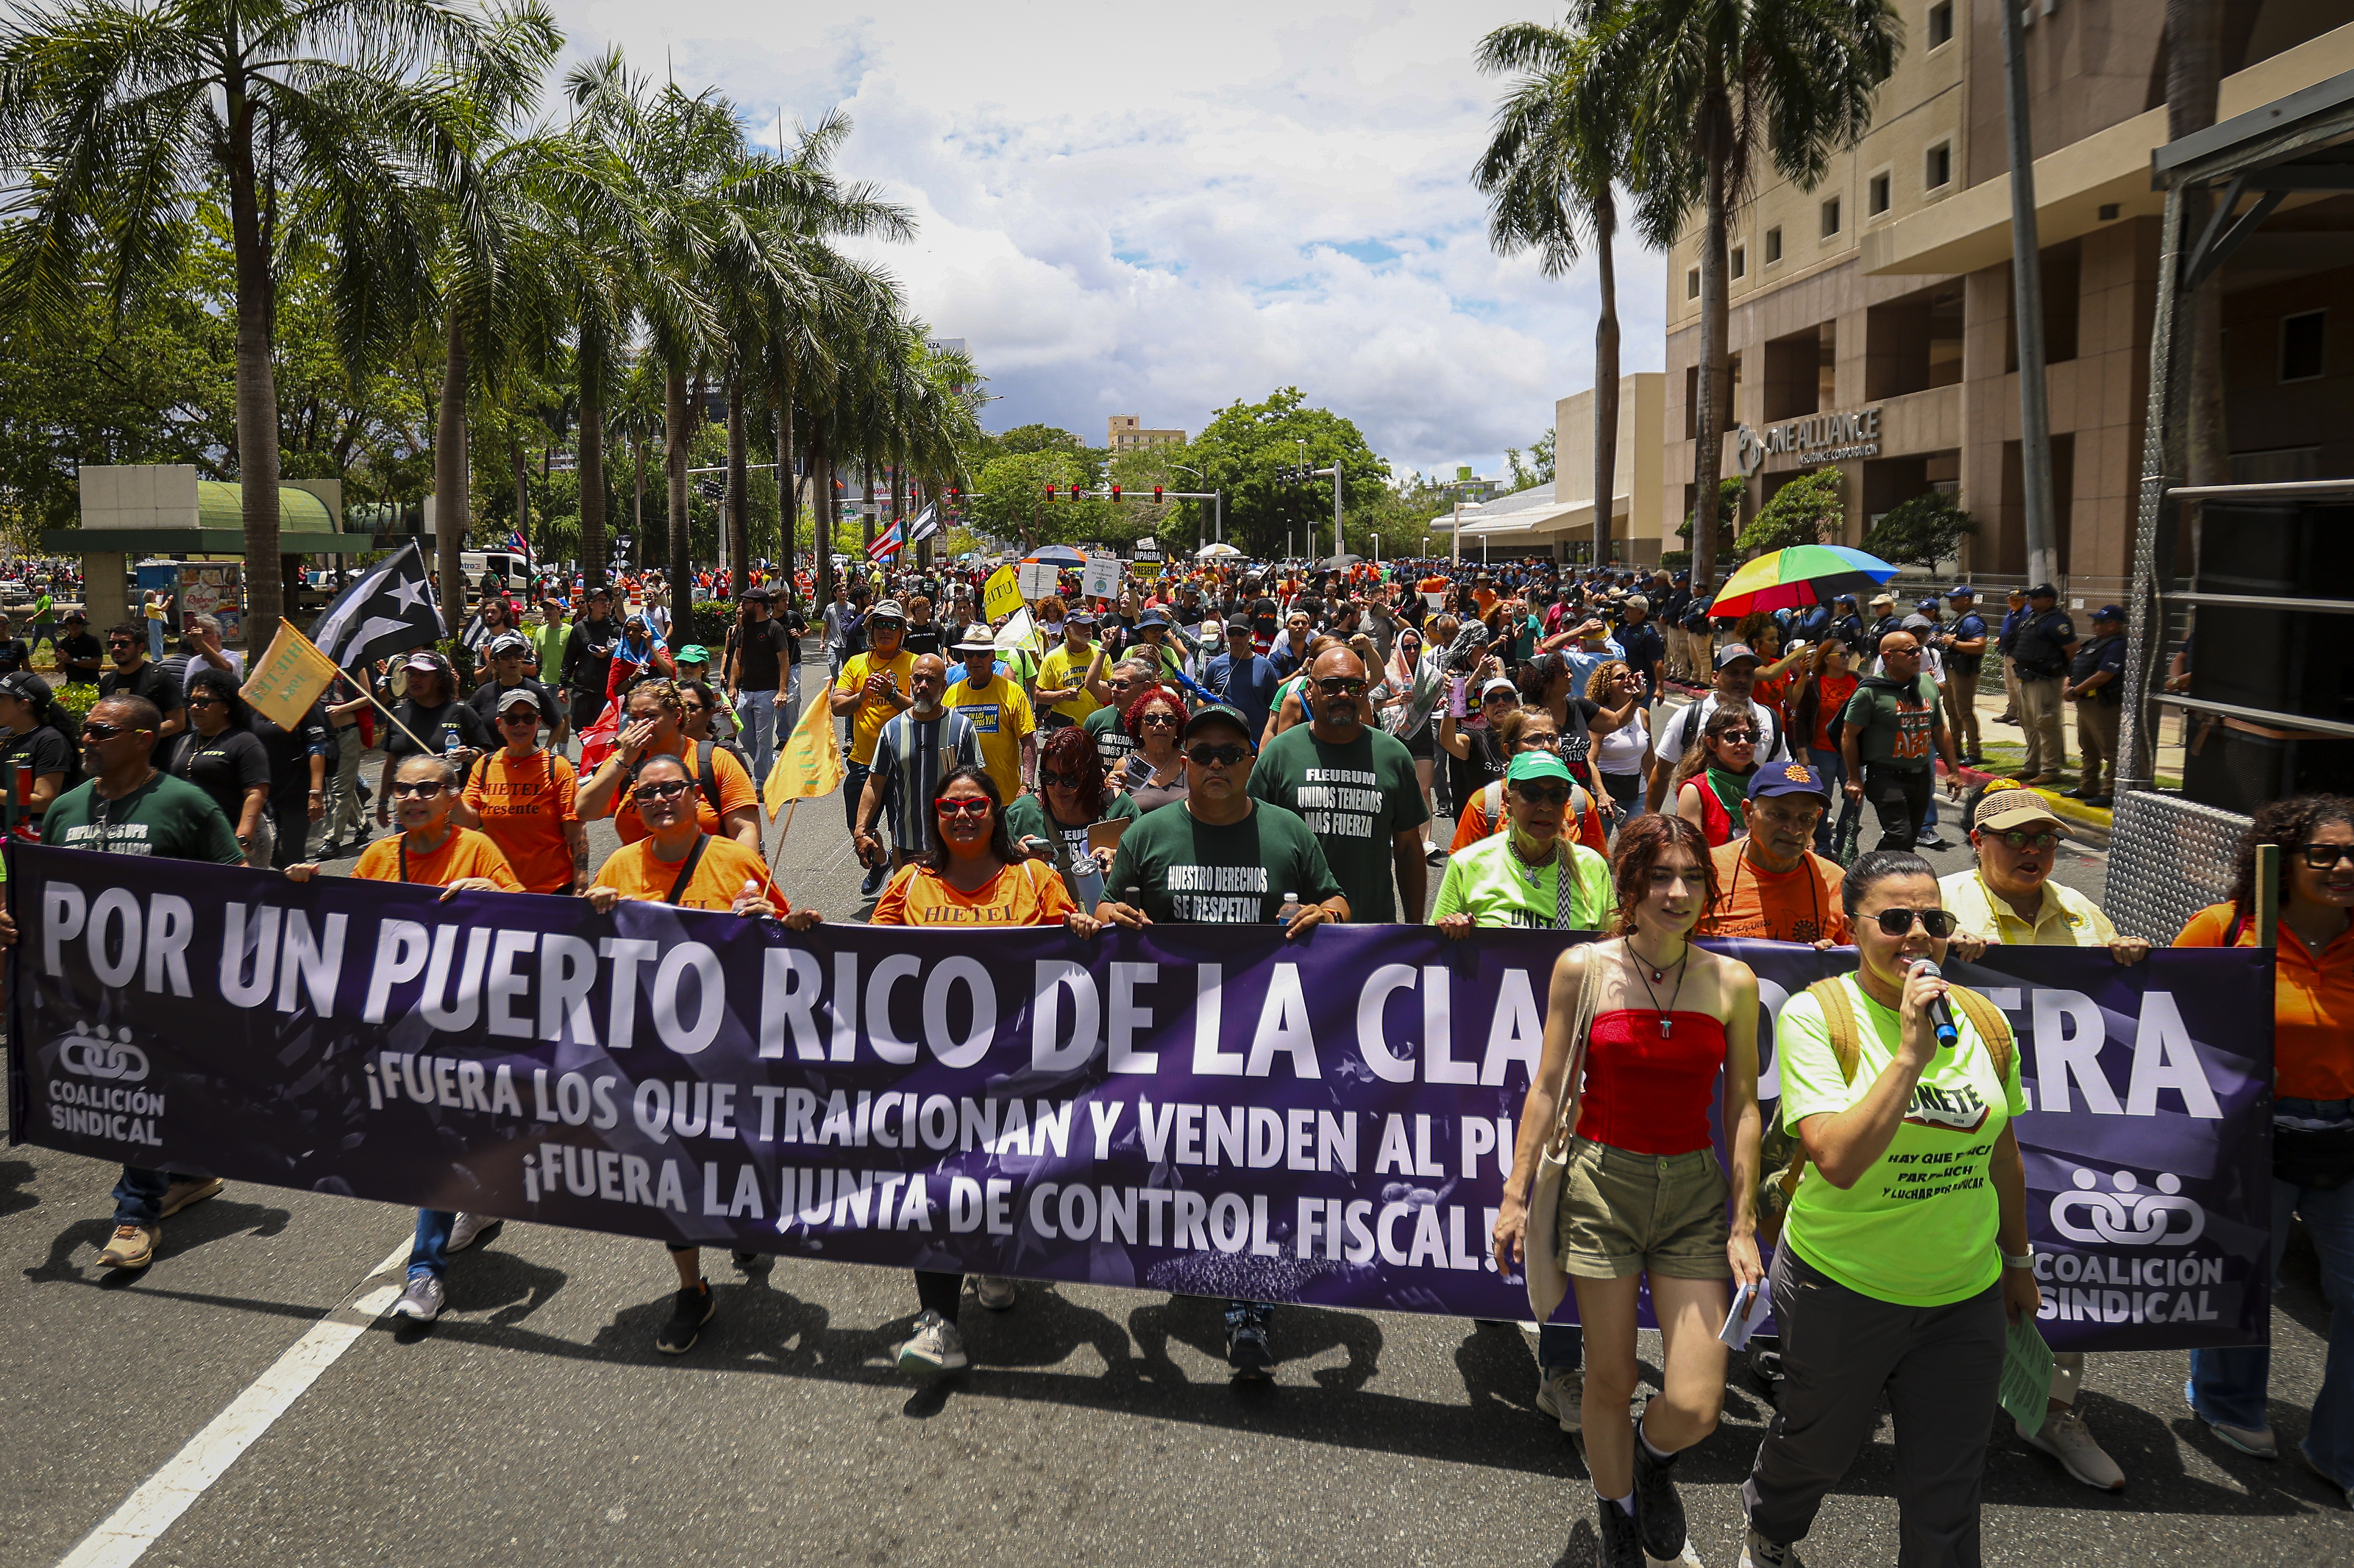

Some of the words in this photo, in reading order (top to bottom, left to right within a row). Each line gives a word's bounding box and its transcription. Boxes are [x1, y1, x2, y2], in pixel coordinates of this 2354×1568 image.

[1766, 424, 1795, 455] ONE
[1798, 407, 1882, 449] ALLIANCE
[1798, 449, 1831, 464] INSURANCE
[1831, 443, 1878, 460] CORPORATION
[1134, 551, 1160, 560] UPAGRA
[1134, 566, 1160, 575] PRESENTE
[483, 783, 543, 796] HIETEL
[1306, 769, 1376, 785] FLEURUM
[481, 802, 540, 814] Presente
[1298, 786, 1336, 808] UNIDOS
[1337, 787, 1383, 813] TENEMOS
[124, 824, 149, 839] UPR
[1305, 809, 1330, 834] MÁS
[1332, 813, 1373, 838] FUERZA
[1168, 866, 1213, 891] NUESTRO
[1215, 866, 1267, 893] DERECHOS
[923, 904, 1019, 922] HIETEL
[1173, 895, 1190, 919] SE
[1192, 896, 1262, 923] RESPETAN
[1512, 908, 1557, 928] UNET
[43, 880, 194, 998] POR
[220, 902, 349, 1018] UN
[363, 918, 725, 1055] PUERTO
[758, 947, 997, 1069] RICO
[1031, 960, 1159, 1075] DE
[1192, 962, 1321, 1080] LA
[1356, 963, 1545, 1086] CLA
[48, 1079, 166, 1117] COALICIÓN
[51, 1105, 163, 1147] SINDICAL
[364, 1052, 522, 1116] ¡FUERA
[533, 1068, 618, 1130] LOS
[633, 1077, 736, 1144] QUE
[753, 1086, 1073, 1158] TRAICIONAN
[1089, 1100, 1124, 1161] Y
[1139, 1101, 1357, 1174] VENDEN
[1375, 1112, 1444, 1177] AL
[1888, 1154, 1920, 1163] HAY
[1921, 1152, 1953, 1164] QUE
[522, 1142, 689, 1213] ¡FUERA
[703, 1161, 764, 1219] LA
[775, 1166, 932, 1235] JUNTA
[947, 1175, 1013, 1236] DE
[1030, 1182, 1280, 1260] CONTROL
[1296, 1197, 1498, 1273] FISCAL!
[1882, 1188, 1891, 1197] Y
[1891, 1188, 1933, 1200] LUCHAR
[2036, 1251, 2224, 1287] COALICIÓN
[2036, 1285, 2219, 1325] SINDICAL
